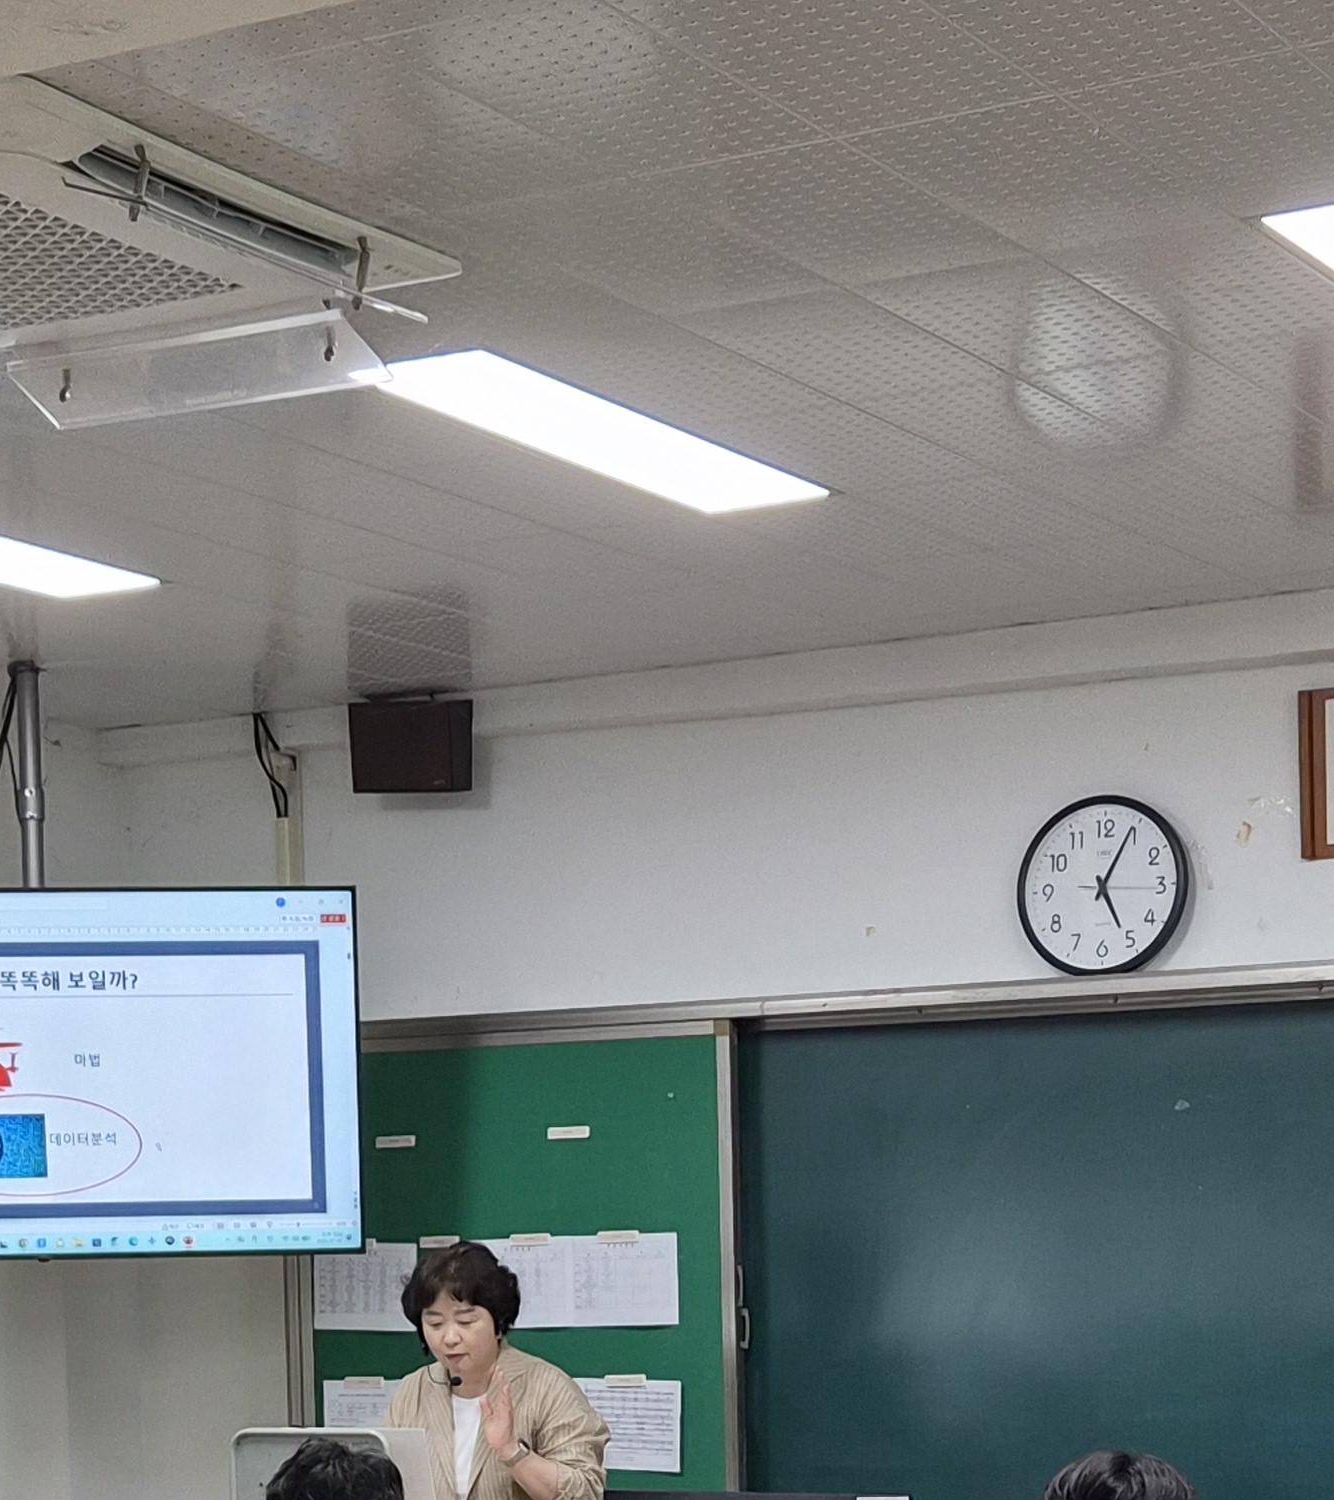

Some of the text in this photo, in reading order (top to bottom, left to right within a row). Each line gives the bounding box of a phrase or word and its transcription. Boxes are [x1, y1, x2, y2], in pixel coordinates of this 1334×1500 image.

[1096, 819, 1115, 839] 12
[1070, 831, 1084, 850] 11
[1049, 853, 1068, 873] 10
[1148, 846, 1160, 866] 2
[1042, 883, 1055, 903] 9
[1155, 876, 1167, 895] 3
[1050, 913, 1062, 933] 8
[1143, 908, 1156, 926] 4
[1070, 933, 1081, 952] 7
[1125, 929, 1136, 948] 5
[1096, 939, 1109, 958] 6
[0, 970, 60, 991] 똑똑해
[67, 970, 139, 991] 보일까?
[74, 1053, 101, 1068] 마법
[49, 1132, 117, 1147] 데이터분석
